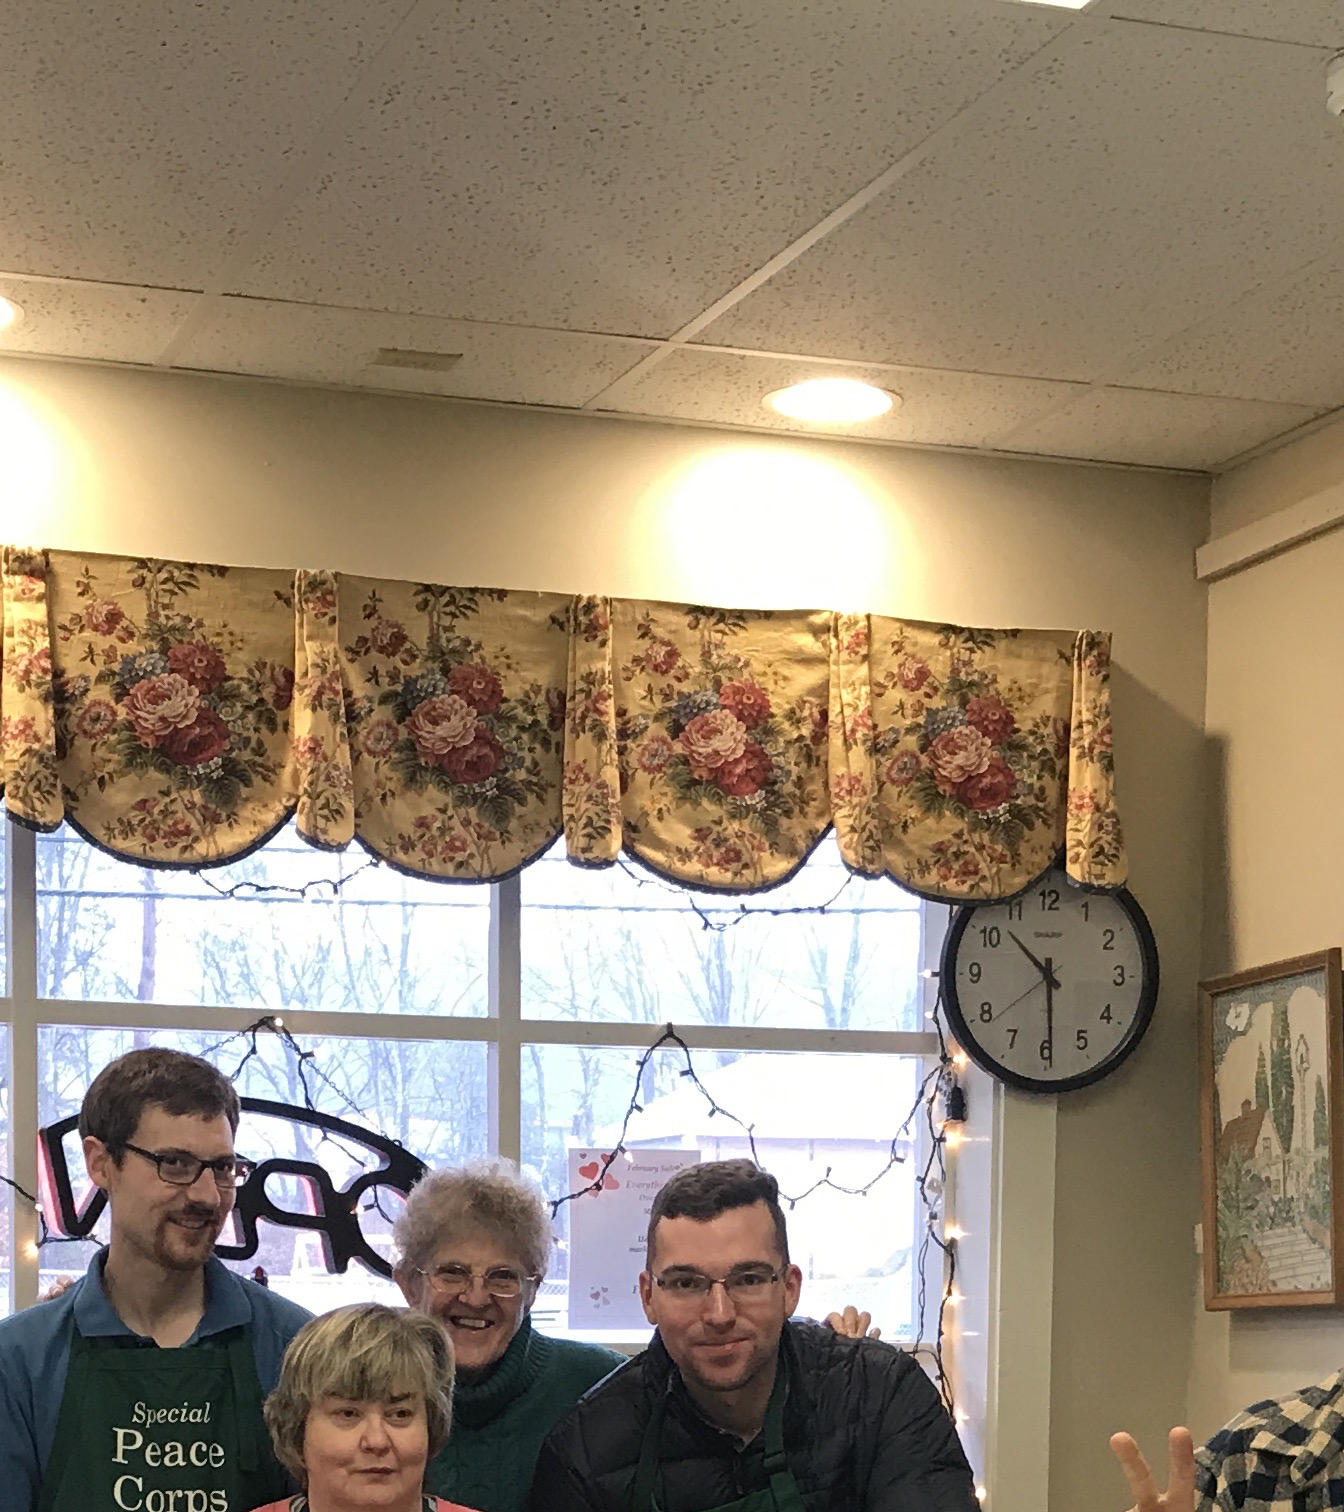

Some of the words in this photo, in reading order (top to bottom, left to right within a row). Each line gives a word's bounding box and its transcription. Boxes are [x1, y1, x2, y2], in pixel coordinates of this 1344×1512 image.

[1008, 899, 1023, 921] 11
[1038, 889, 1060, 911] 12
[1081, 902, 1089, 922] 1
[979, 926, 1001, 949] 10
[1102, 929, 1115, 950] 2
[968, 962, 982, 984] 9
[1112, 965, 1125, 986] 3
[979, 1001, 992, 1023] 8
[1099, 1003, 1112, 1024] 4
[1006, 1028, 1018, 1049] 7
[1075, 1029, 1088, 1050] 5
[1039, 1039, 1052, 1061] 6
[131, 1401, 211, 1428] Special
[111, 1427, 225, 1468] Peace
